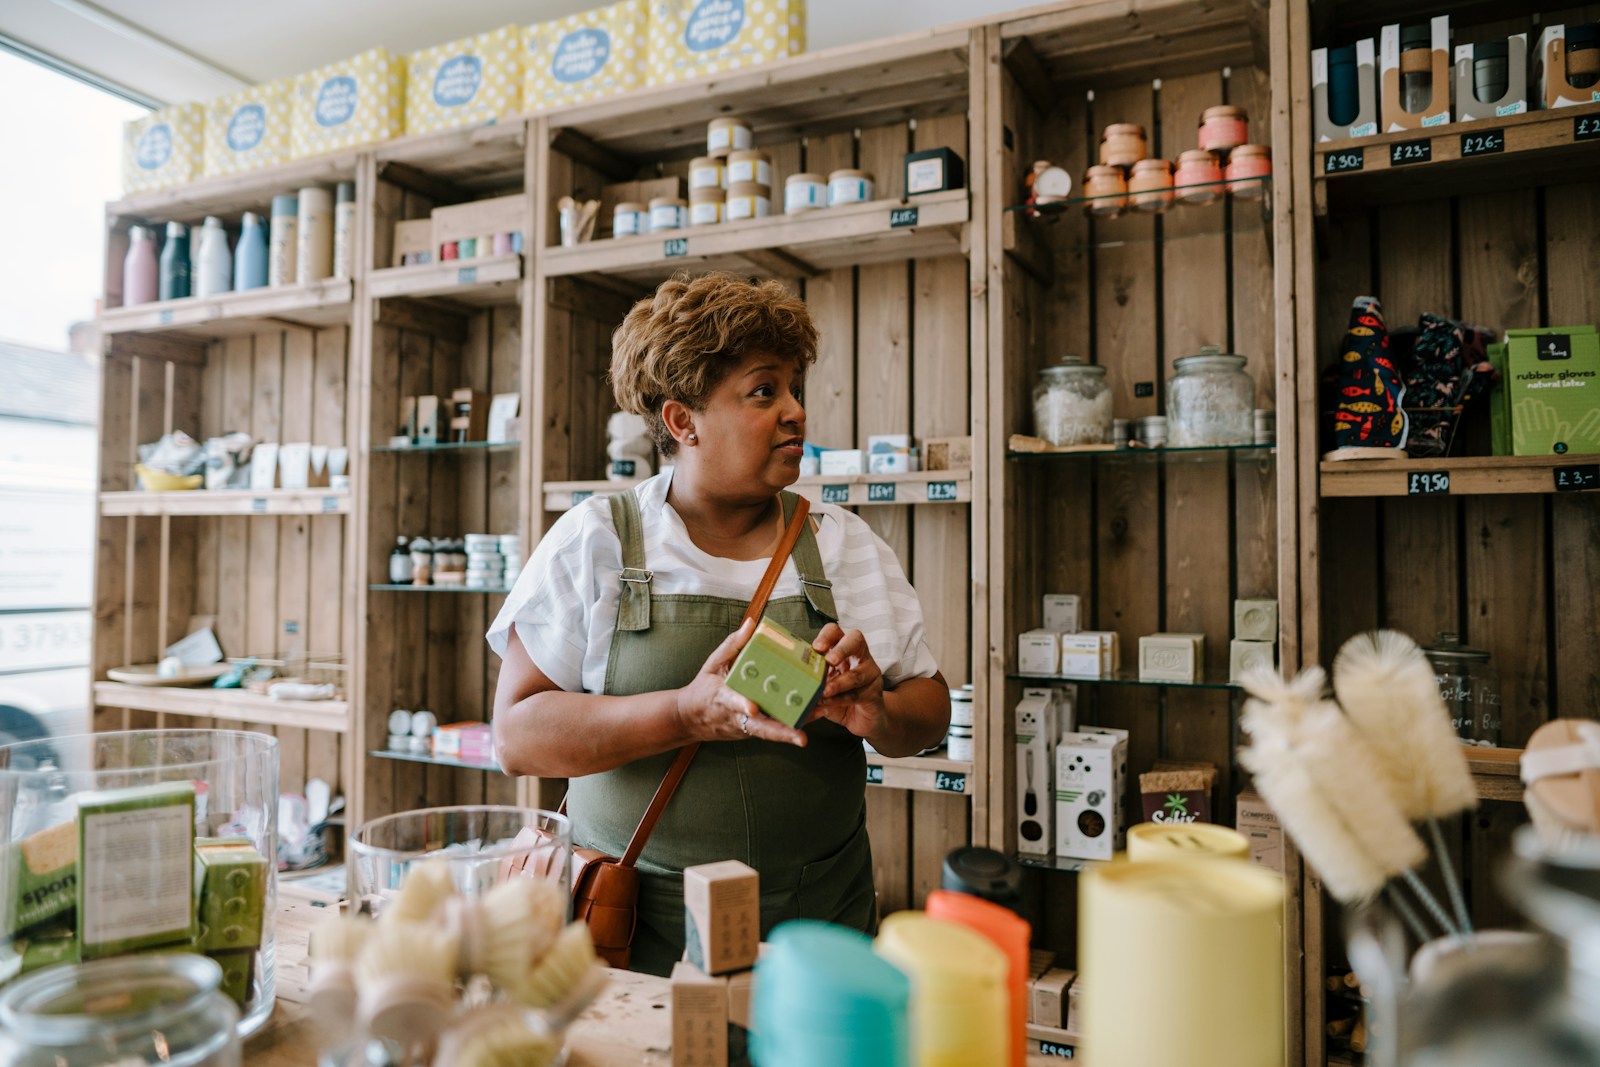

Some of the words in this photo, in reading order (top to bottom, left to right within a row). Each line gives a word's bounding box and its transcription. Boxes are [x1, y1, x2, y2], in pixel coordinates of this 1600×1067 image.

[1516, 371, 1556, 381] rubber
[1558, 369, 1597, 381] gloves
[1527, 380, 1561, 389] natural
[1562, 379, 1586, 388] latex
[1409, 473, 1449, 493] £9.50
[21, 873, 78, 906] spon
